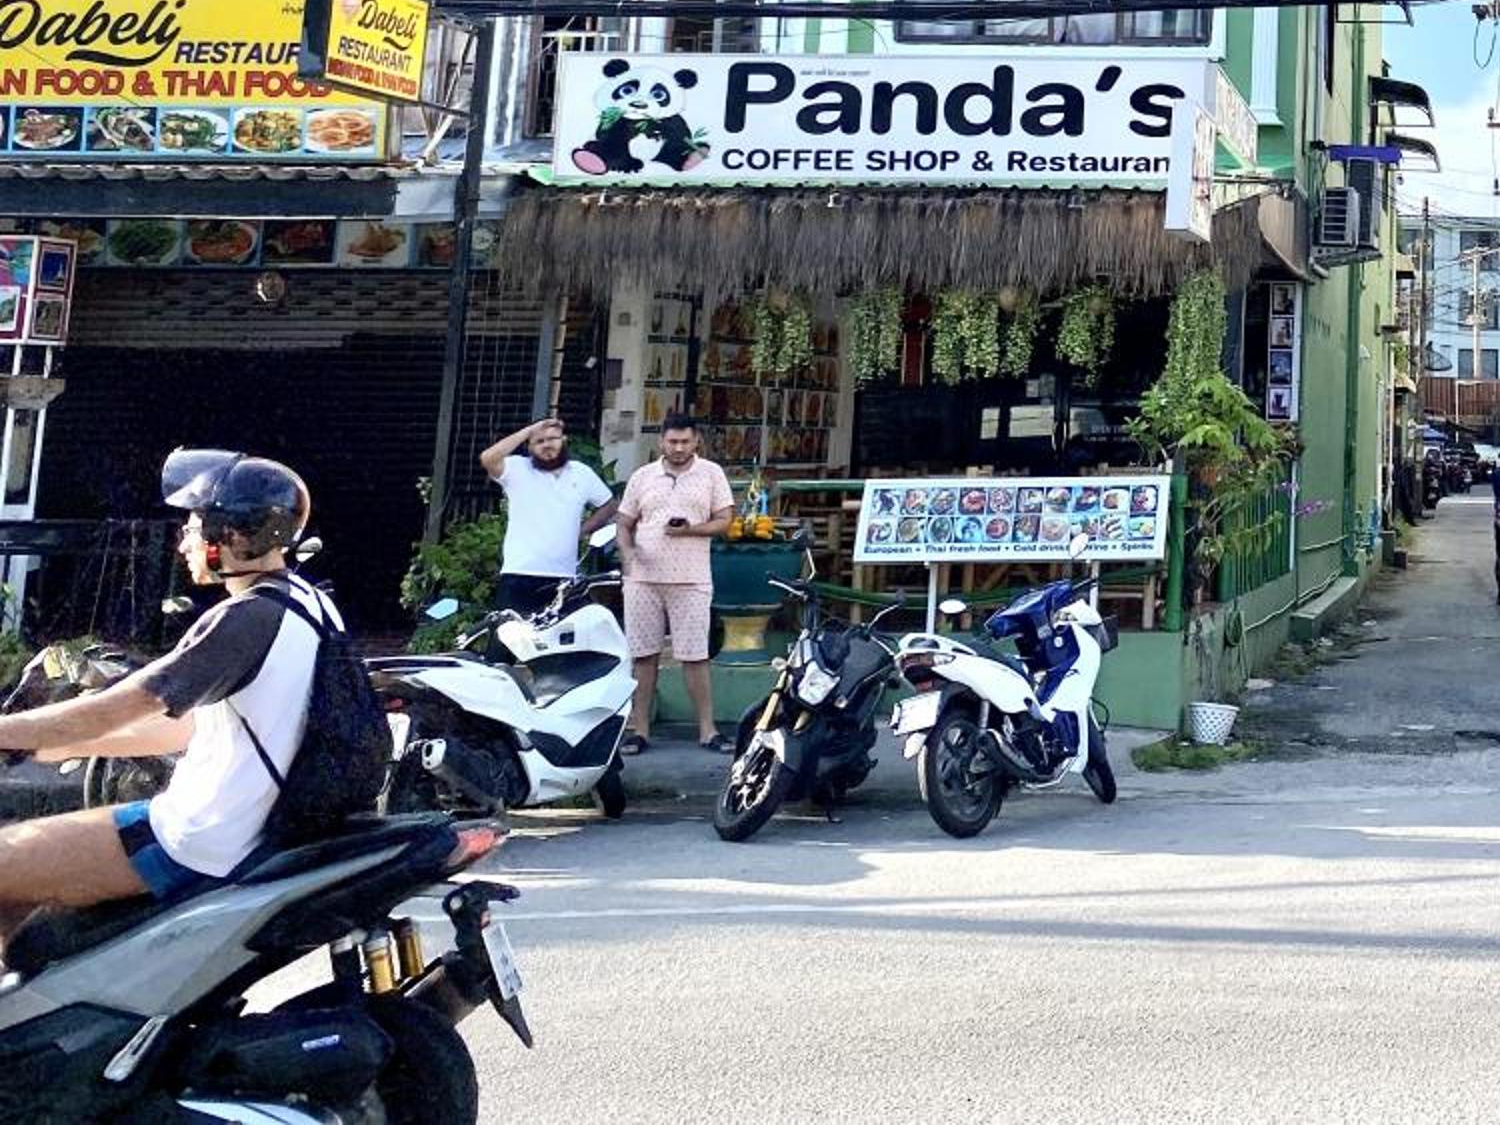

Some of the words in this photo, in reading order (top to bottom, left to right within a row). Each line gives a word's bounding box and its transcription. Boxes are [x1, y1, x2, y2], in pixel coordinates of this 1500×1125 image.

[338, 35, 413, 73] RESTAURANT
[34, 68, 126, 97] FOOD
[132, 69, 156, 98] &
[162, 70, 237, 98] THAI
[724, 61, 1186, 138] Panda's
[722, 148, 854, 171] COFFEE
[866, 149, 960, 172] SHOP
[972, 151, 994, 172] &
